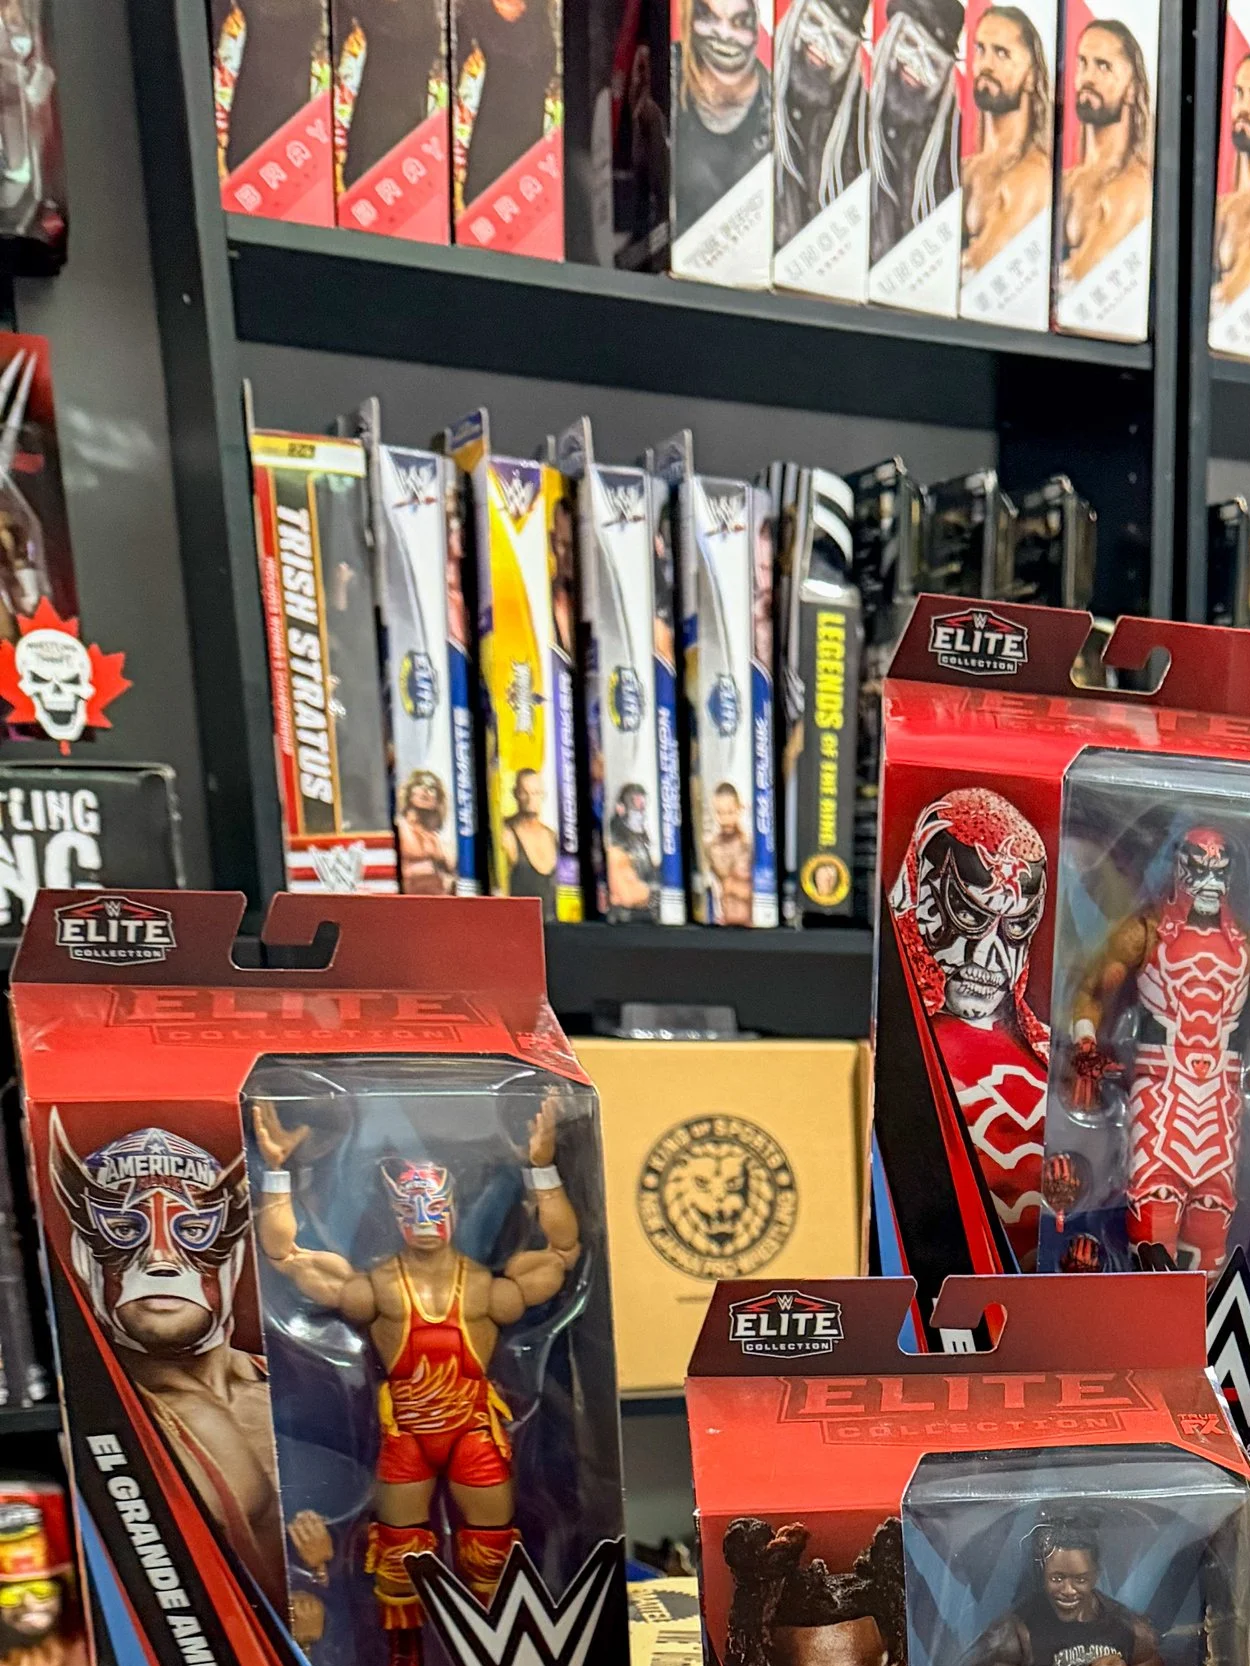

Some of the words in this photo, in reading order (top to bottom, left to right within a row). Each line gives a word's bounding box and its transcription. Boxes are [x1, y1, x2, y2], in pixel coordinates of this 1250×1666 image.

[276, 505, 319, 625] TRISH
[933, 626, 1025, 658] ELITE
[815, 611, 847, 731] LEGENDS
[941, 655, 1015, 672] COLLECTION
[287, 629, 334, 804] STRATUS
[62, 919, 171, 943] ELITE
[74, 949, 162, 957] COLLECTION
[123, 990, 471, 1021] ELITE
[169, 1029, 446, 1043] COLLECTION
[102, 1153, 218, 1186] AMERICAN
[733, 1312, 838, 1337] ELITE
[746, 1342, 833, 1352] COLLECTION
[799, 1374, 1134, 1415] ELITE
[837, 1417, 1107, 1439] COLLECTION
[1180, 1419, 1227, 1436] FX
[85, 1433, 128, 1472] EL
[107, 1475, 191, 1610] GRANDE
